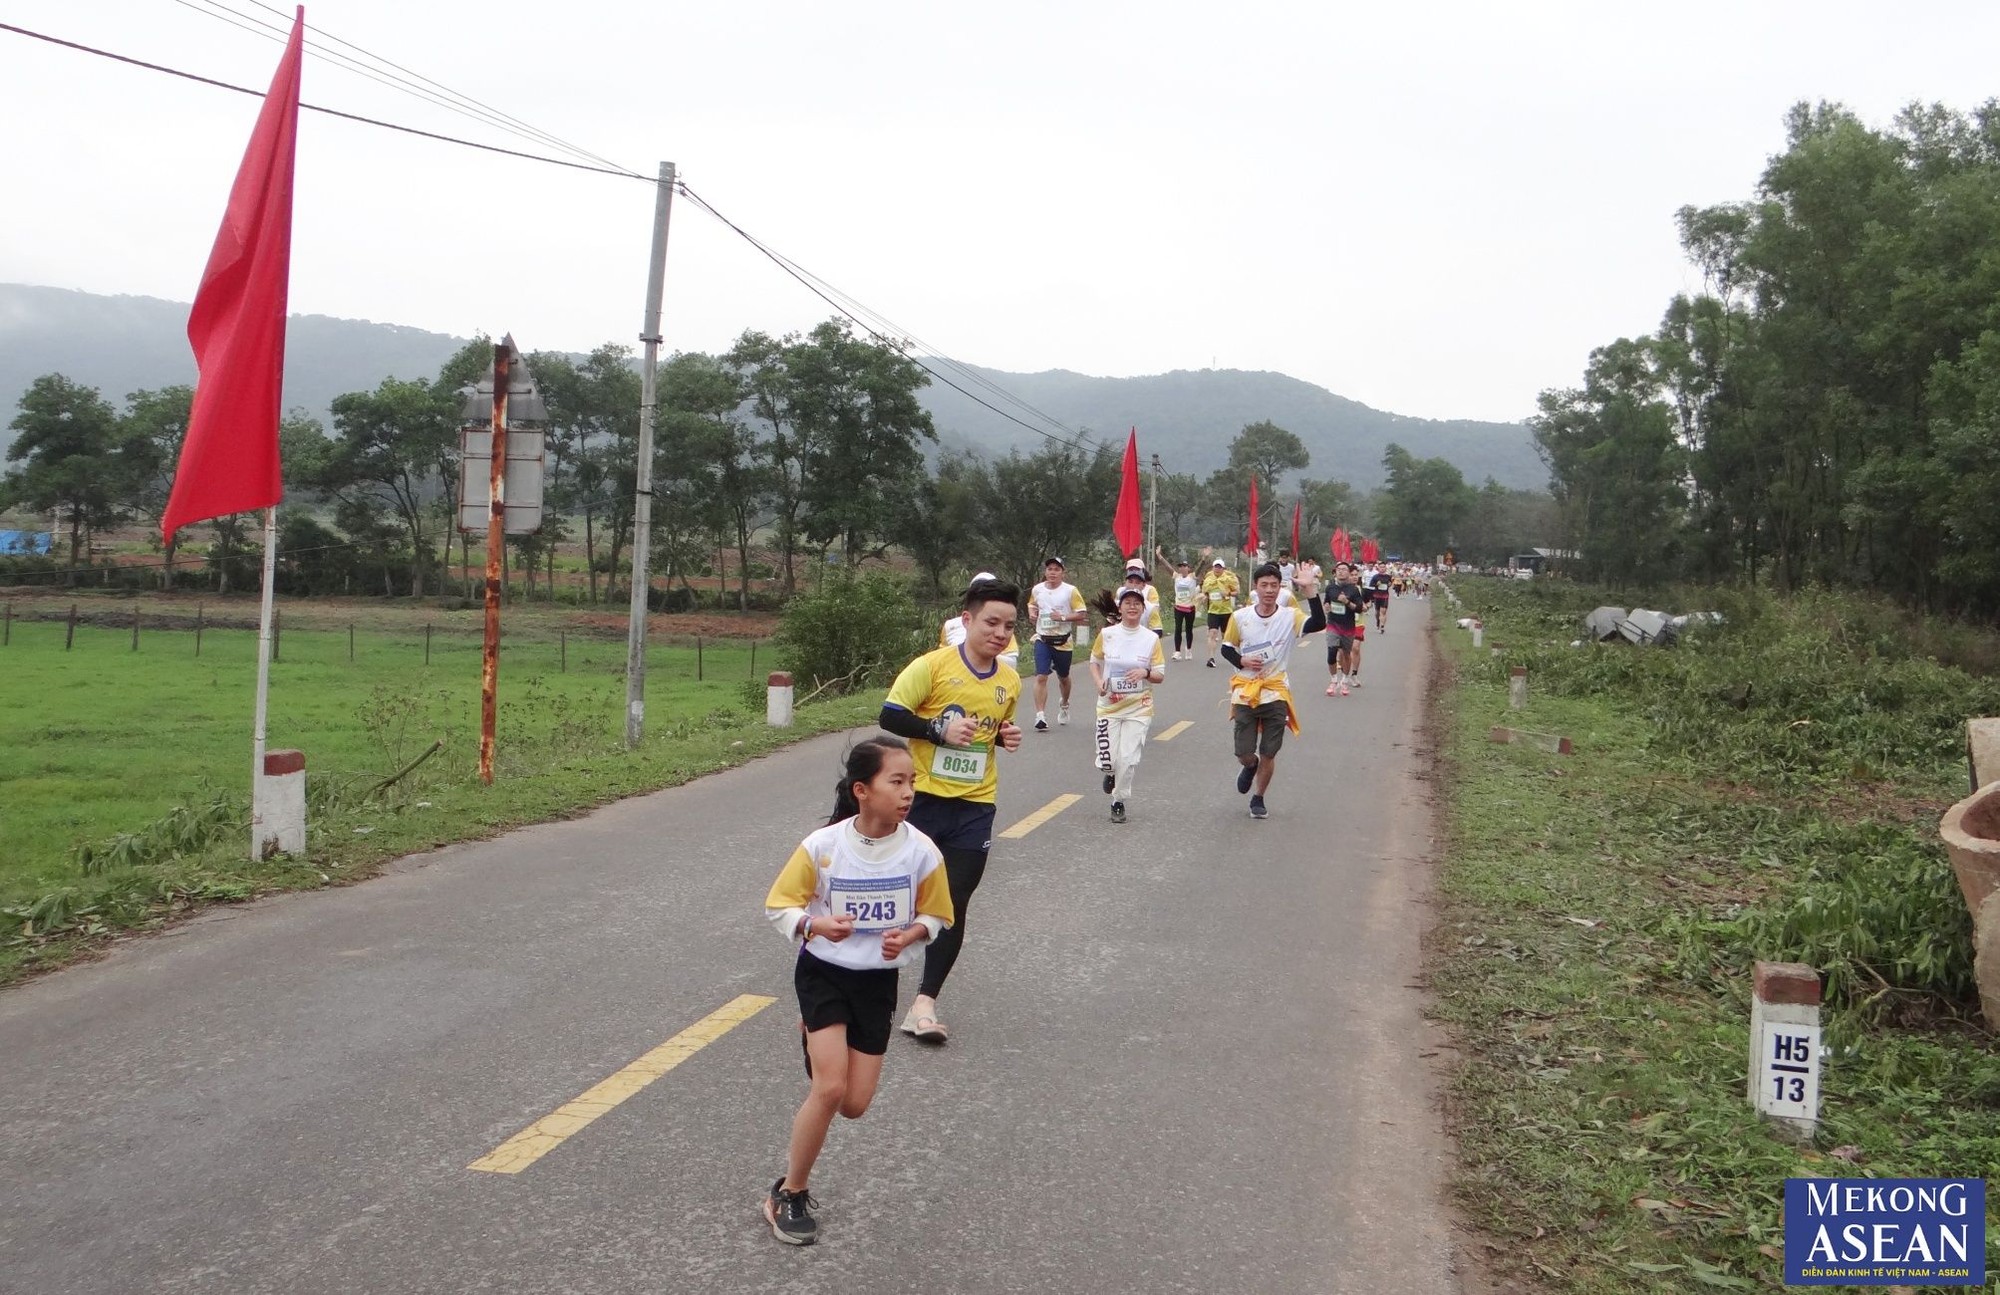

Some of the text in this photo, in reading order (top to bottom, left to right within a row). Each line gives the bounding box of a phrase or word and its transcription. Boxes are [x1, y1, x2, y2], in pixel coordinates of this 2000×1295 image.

[943, 756, 977, 774] 8034
[845, 901, 896, 921] 5243
[1774, 1034, 1809, 1062] H5
[1773, 1076, 1805, 1103] 13
